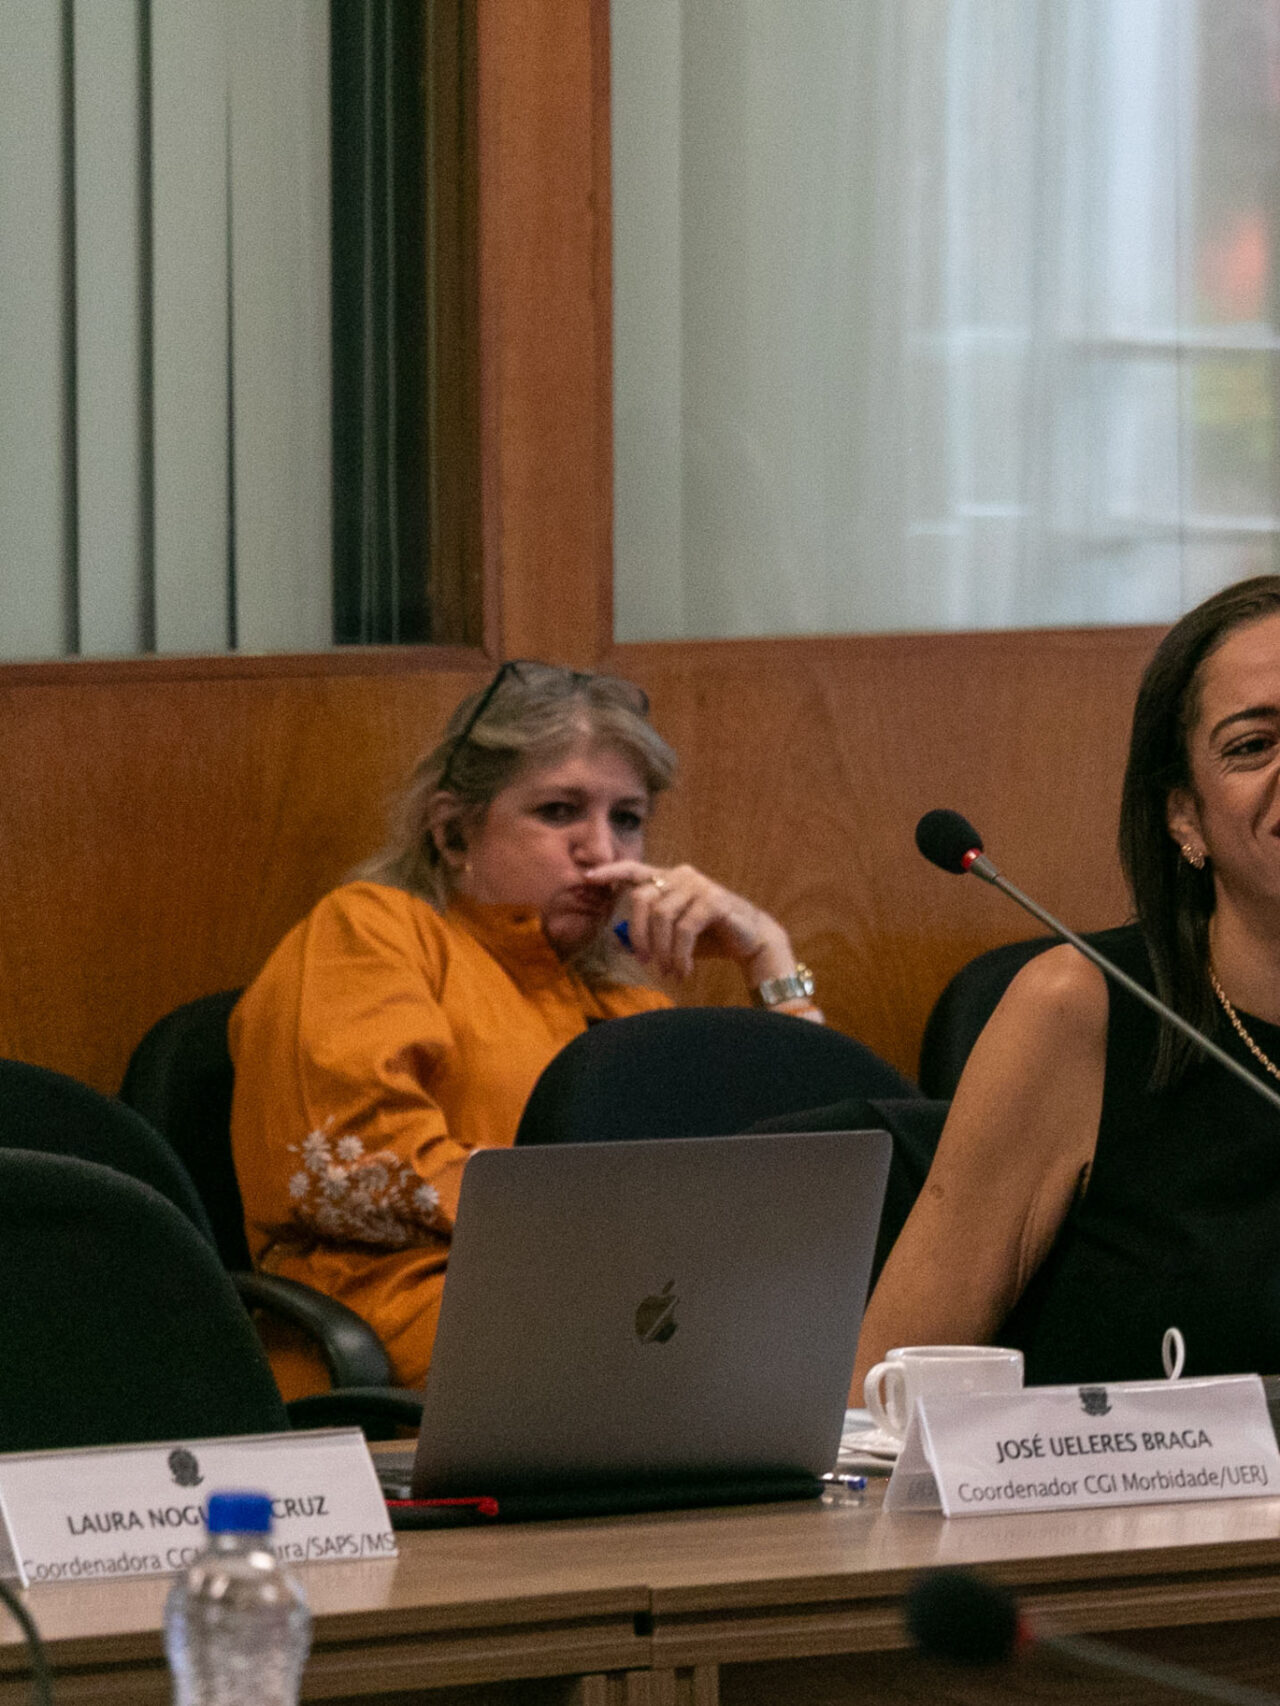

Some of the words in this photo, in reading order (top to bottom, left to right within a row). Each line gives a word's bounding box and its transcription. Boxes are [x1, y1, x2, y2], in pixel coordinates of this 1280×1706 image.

[996, 1433, 1045, 1463] JOSÉ
[1050, 1432, 1137, 1458] UELERES
[1143, 1429, 1213, 1451] BRAGA
[958, 1477, 1078, 1503] Coordenador
[1084, 1474, 1116, 1495] CGI
[1122, 1464, 1269, 1491] Morbidade/UERJ
[67, 1510, 144, 1535] LAURA
[270, 1496, 329, 1519] CRUZ
